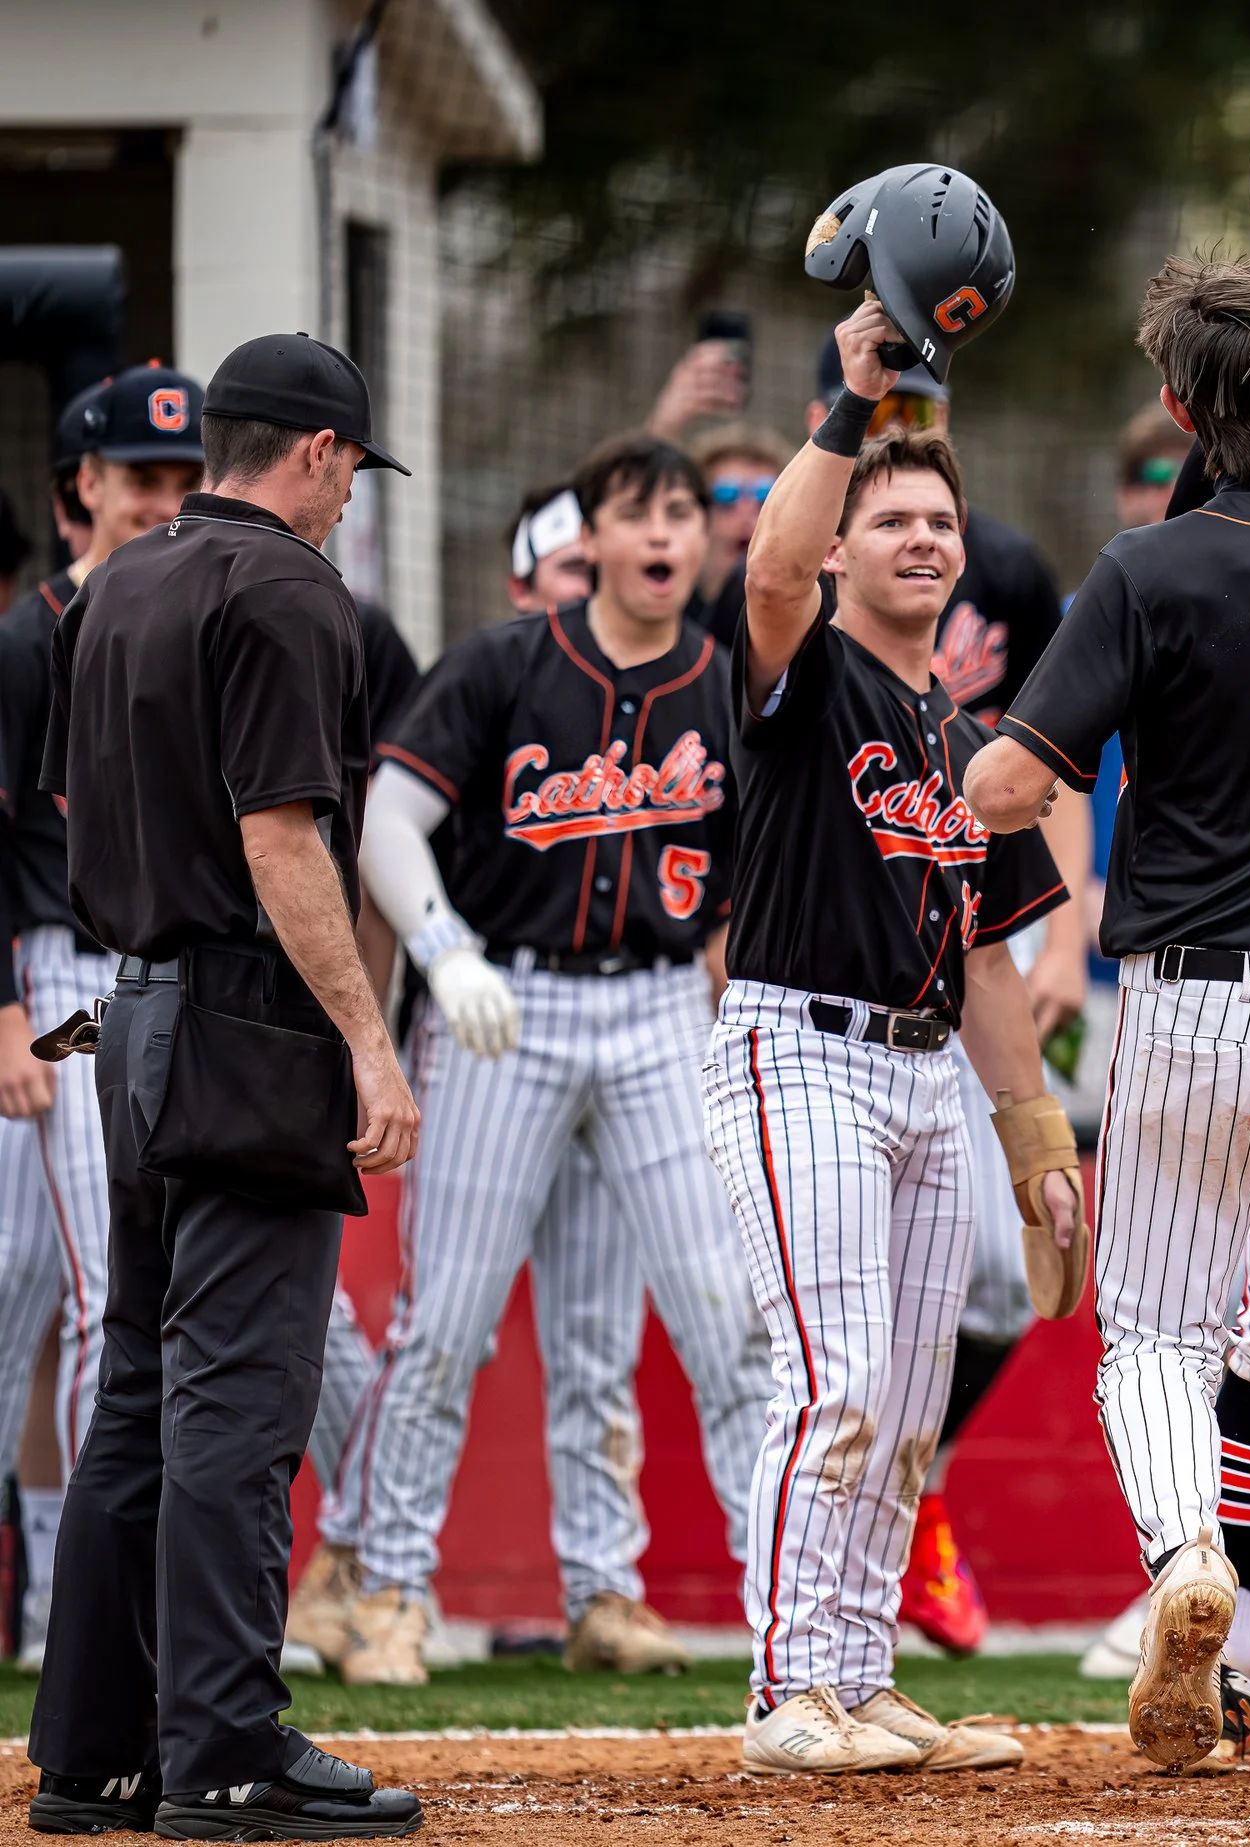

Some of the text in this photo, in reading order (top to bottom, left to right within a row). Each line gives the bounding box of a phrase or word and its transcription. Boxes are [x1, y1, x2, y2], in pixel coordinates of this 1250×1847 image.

[933, 286, 988, 333] C
[148, 387, 189, 432] C
[502, 730, 726, 824] Catholic
[657, 844, 711, 920] 5
